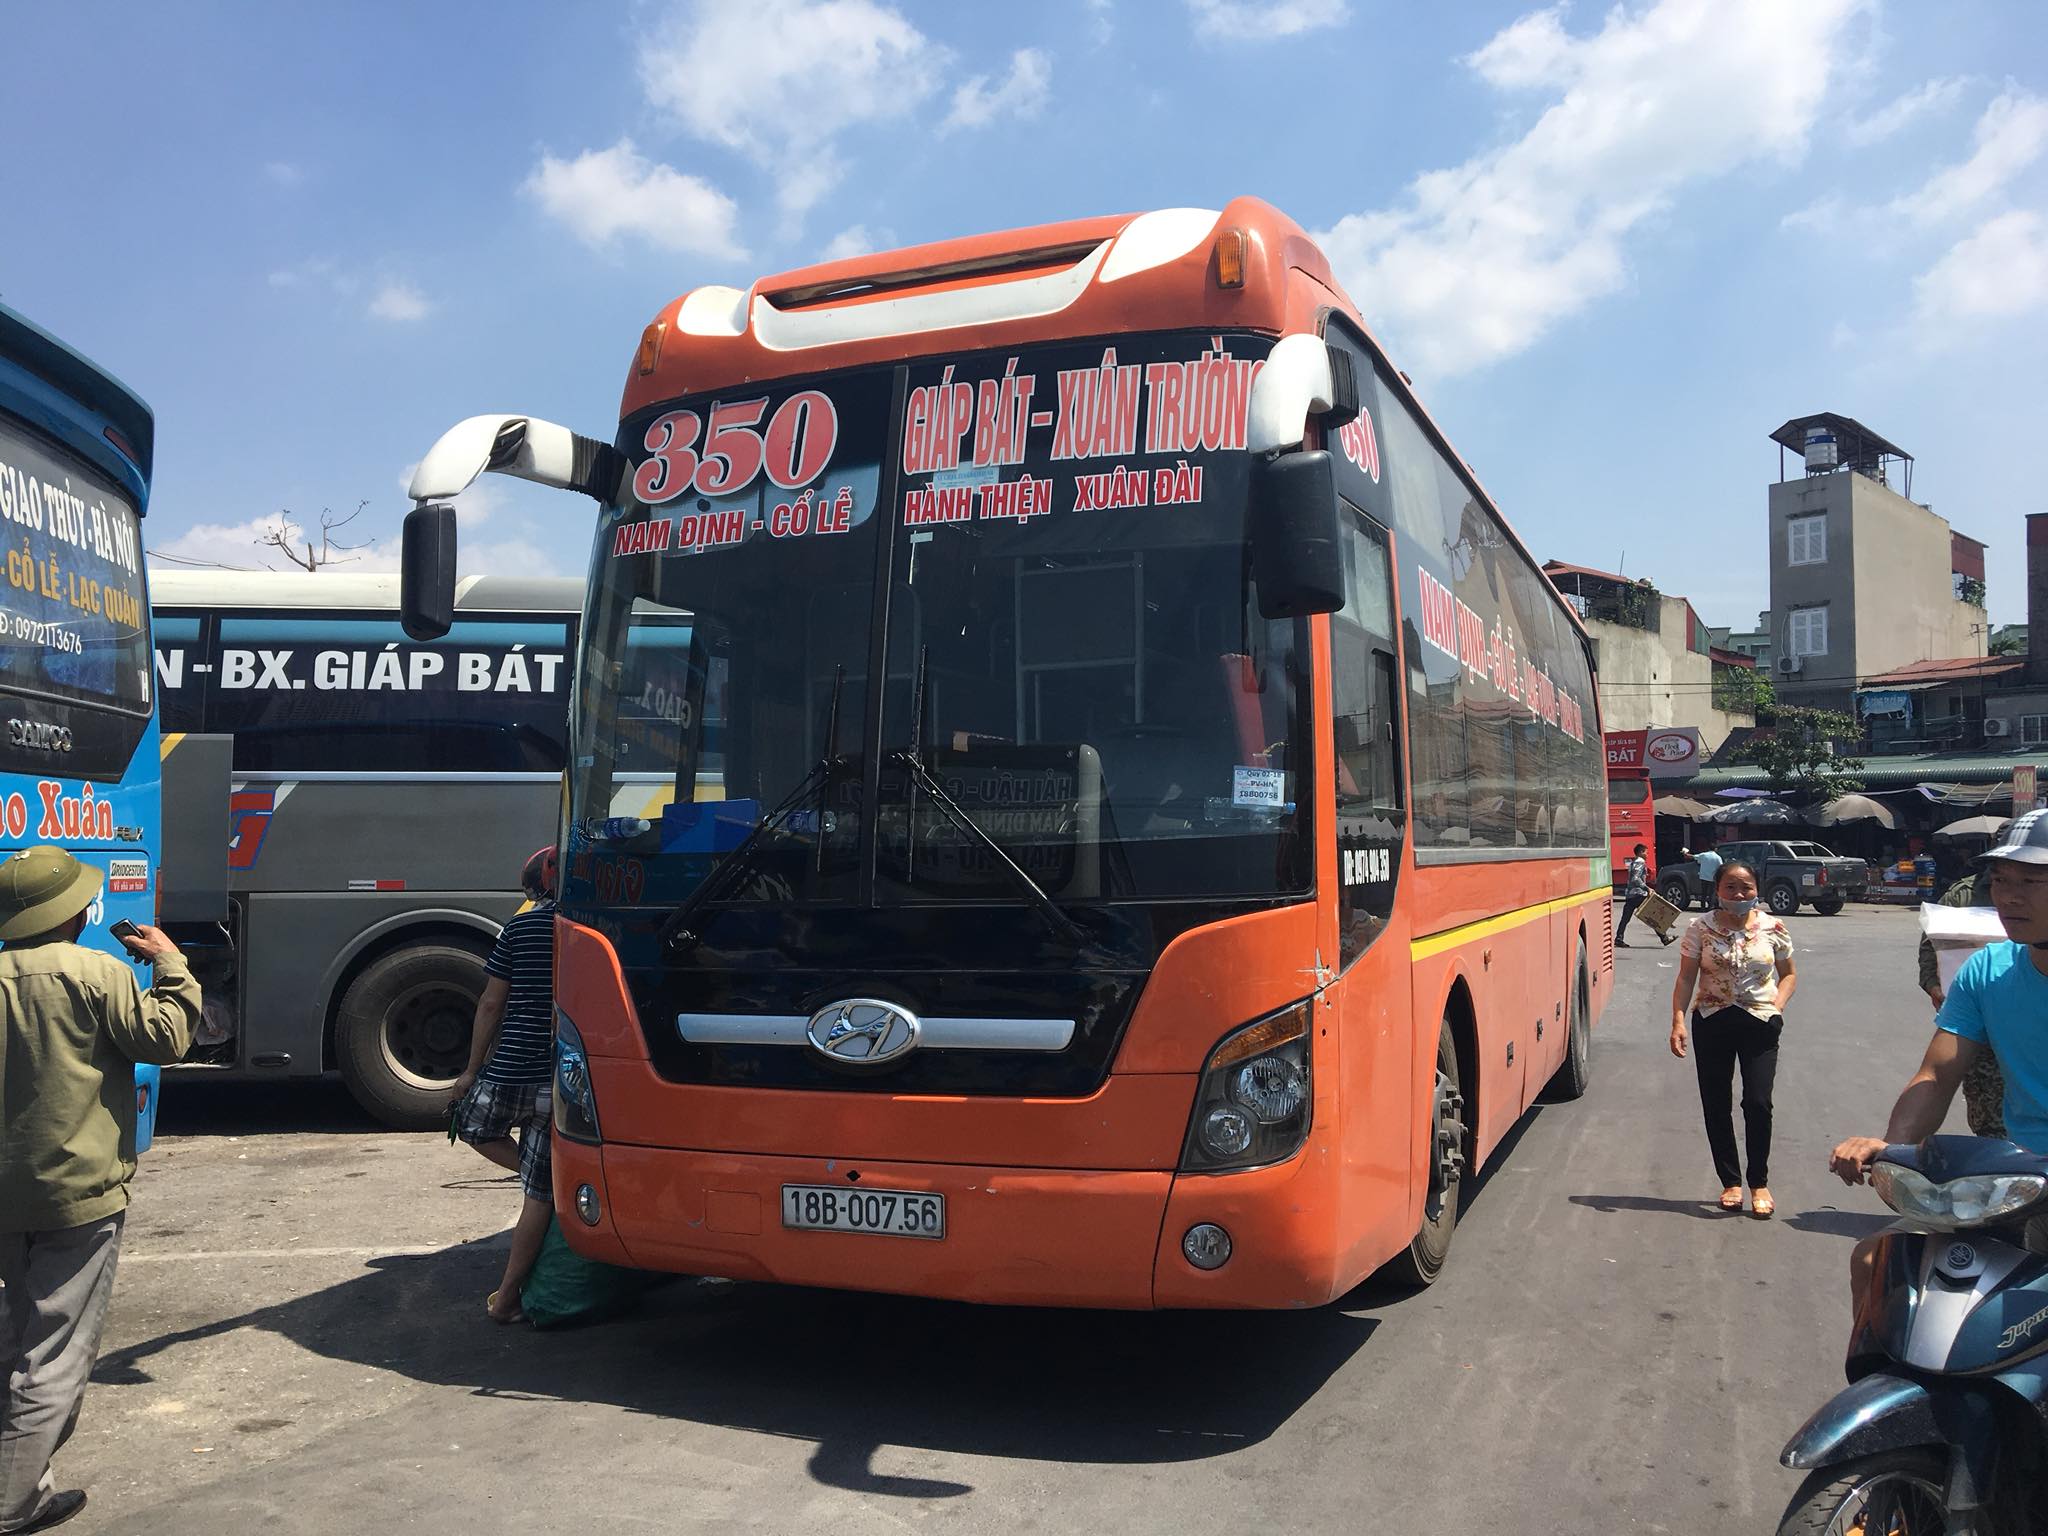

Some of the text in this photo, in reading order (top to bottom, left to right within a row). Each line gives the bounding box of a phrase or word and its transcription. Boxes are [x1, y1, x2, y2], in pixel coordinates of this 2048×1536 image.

[904, 365, 974, 475] GIÁP
[972, 357, 1036, 468] BÁT
[1050, 347, 1141, 460] XUÂN
[1145, 336, 1266, 453] TRƯỜN
[633, 390, 838, 504] 350
[0, 461, 42, 531] GIAO
[613, 519, 672, 557] NAM
[678, 510, 746, 554] ĐỊNH
[770, 489, 815, 538] CỔ
[815, 486, 852, 534] LỄ
[904, 460, 1203, 526] HÀNH THIỆN XUÂN ĐÀI
[7, 536, 35, 592] CỔ
[15, 616, 82, 655] 0972113676
[1418, 564, 1458, 661] NAM
[314, 643, 444, 691] GIÁP
[457, 644, 564, 693] BÁT
[1608, 747, 1637, 763] BÁT
[38, 780, 114, 840] Xuân
[791, 1190, 937, 1232] 18B-007.56
